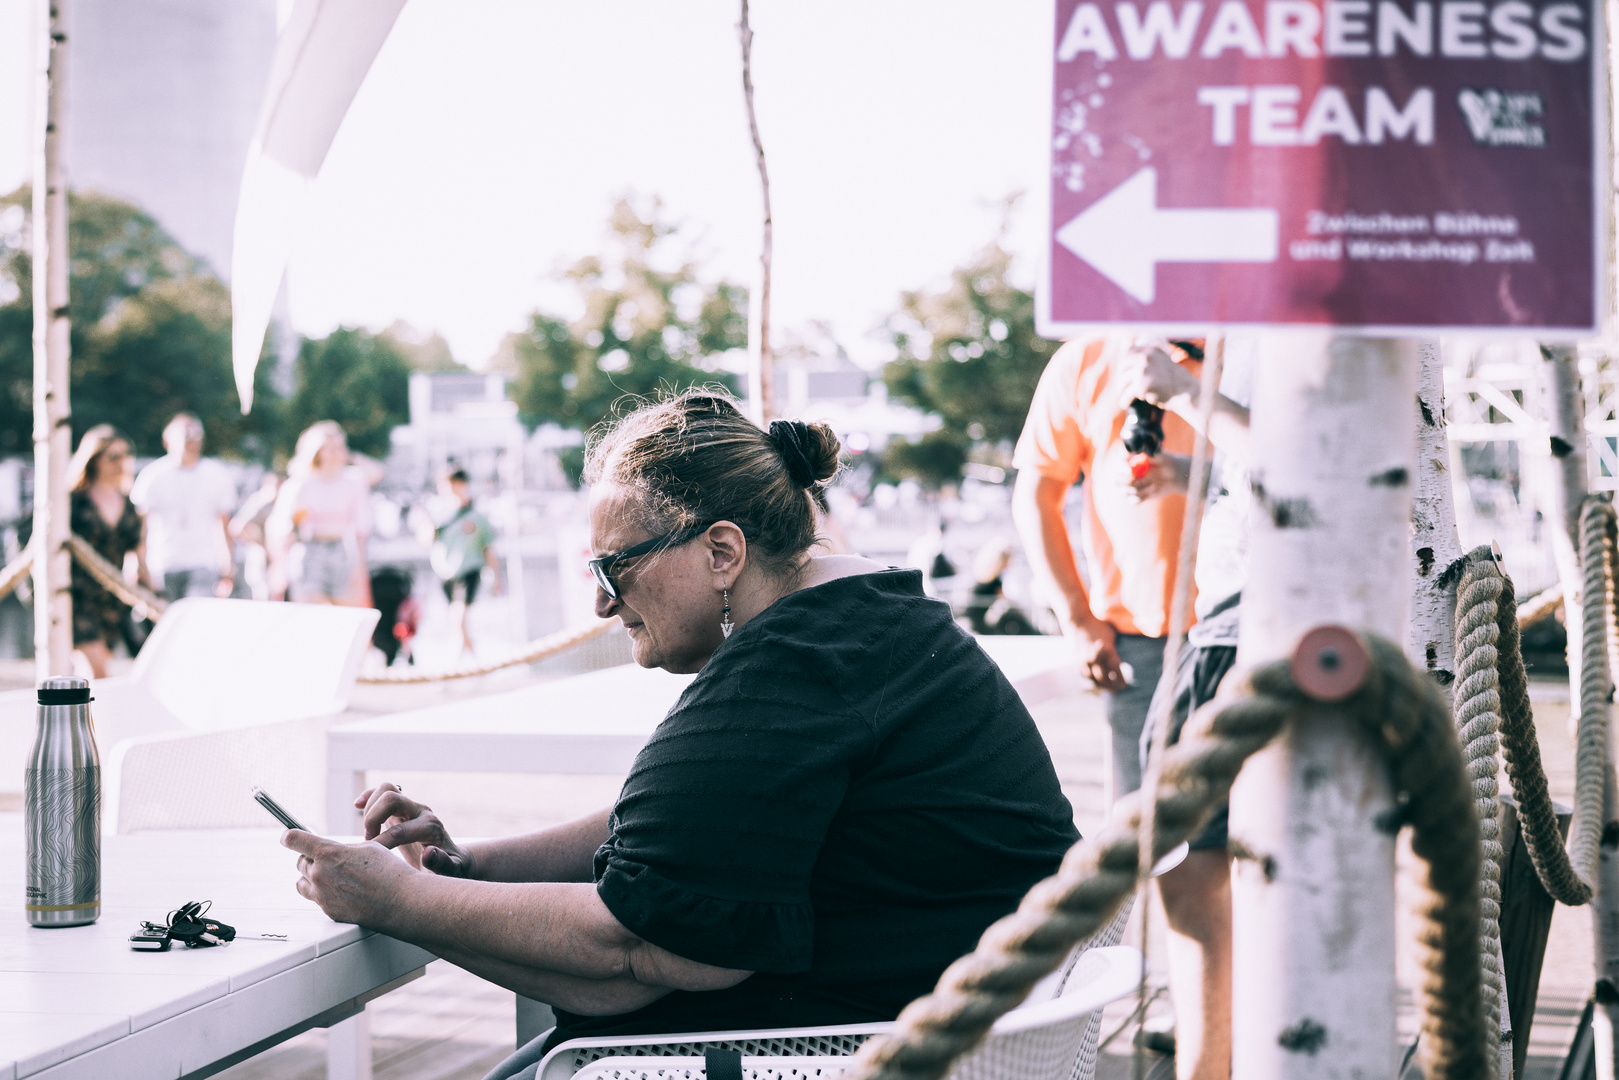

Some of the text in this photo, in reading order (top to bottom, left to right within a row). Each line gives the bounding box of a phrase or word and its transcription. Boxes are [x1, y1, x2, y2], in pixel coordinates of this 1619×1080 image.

[1058, 1, 1587, 60] AWARENESS
[1198, 86, 1435, 146] TEAM
[1307, 211, 1429, 234] Zwischen
[1290, 239, 1342, 261] und
[1348, 240, 1479, 264] Workshop
